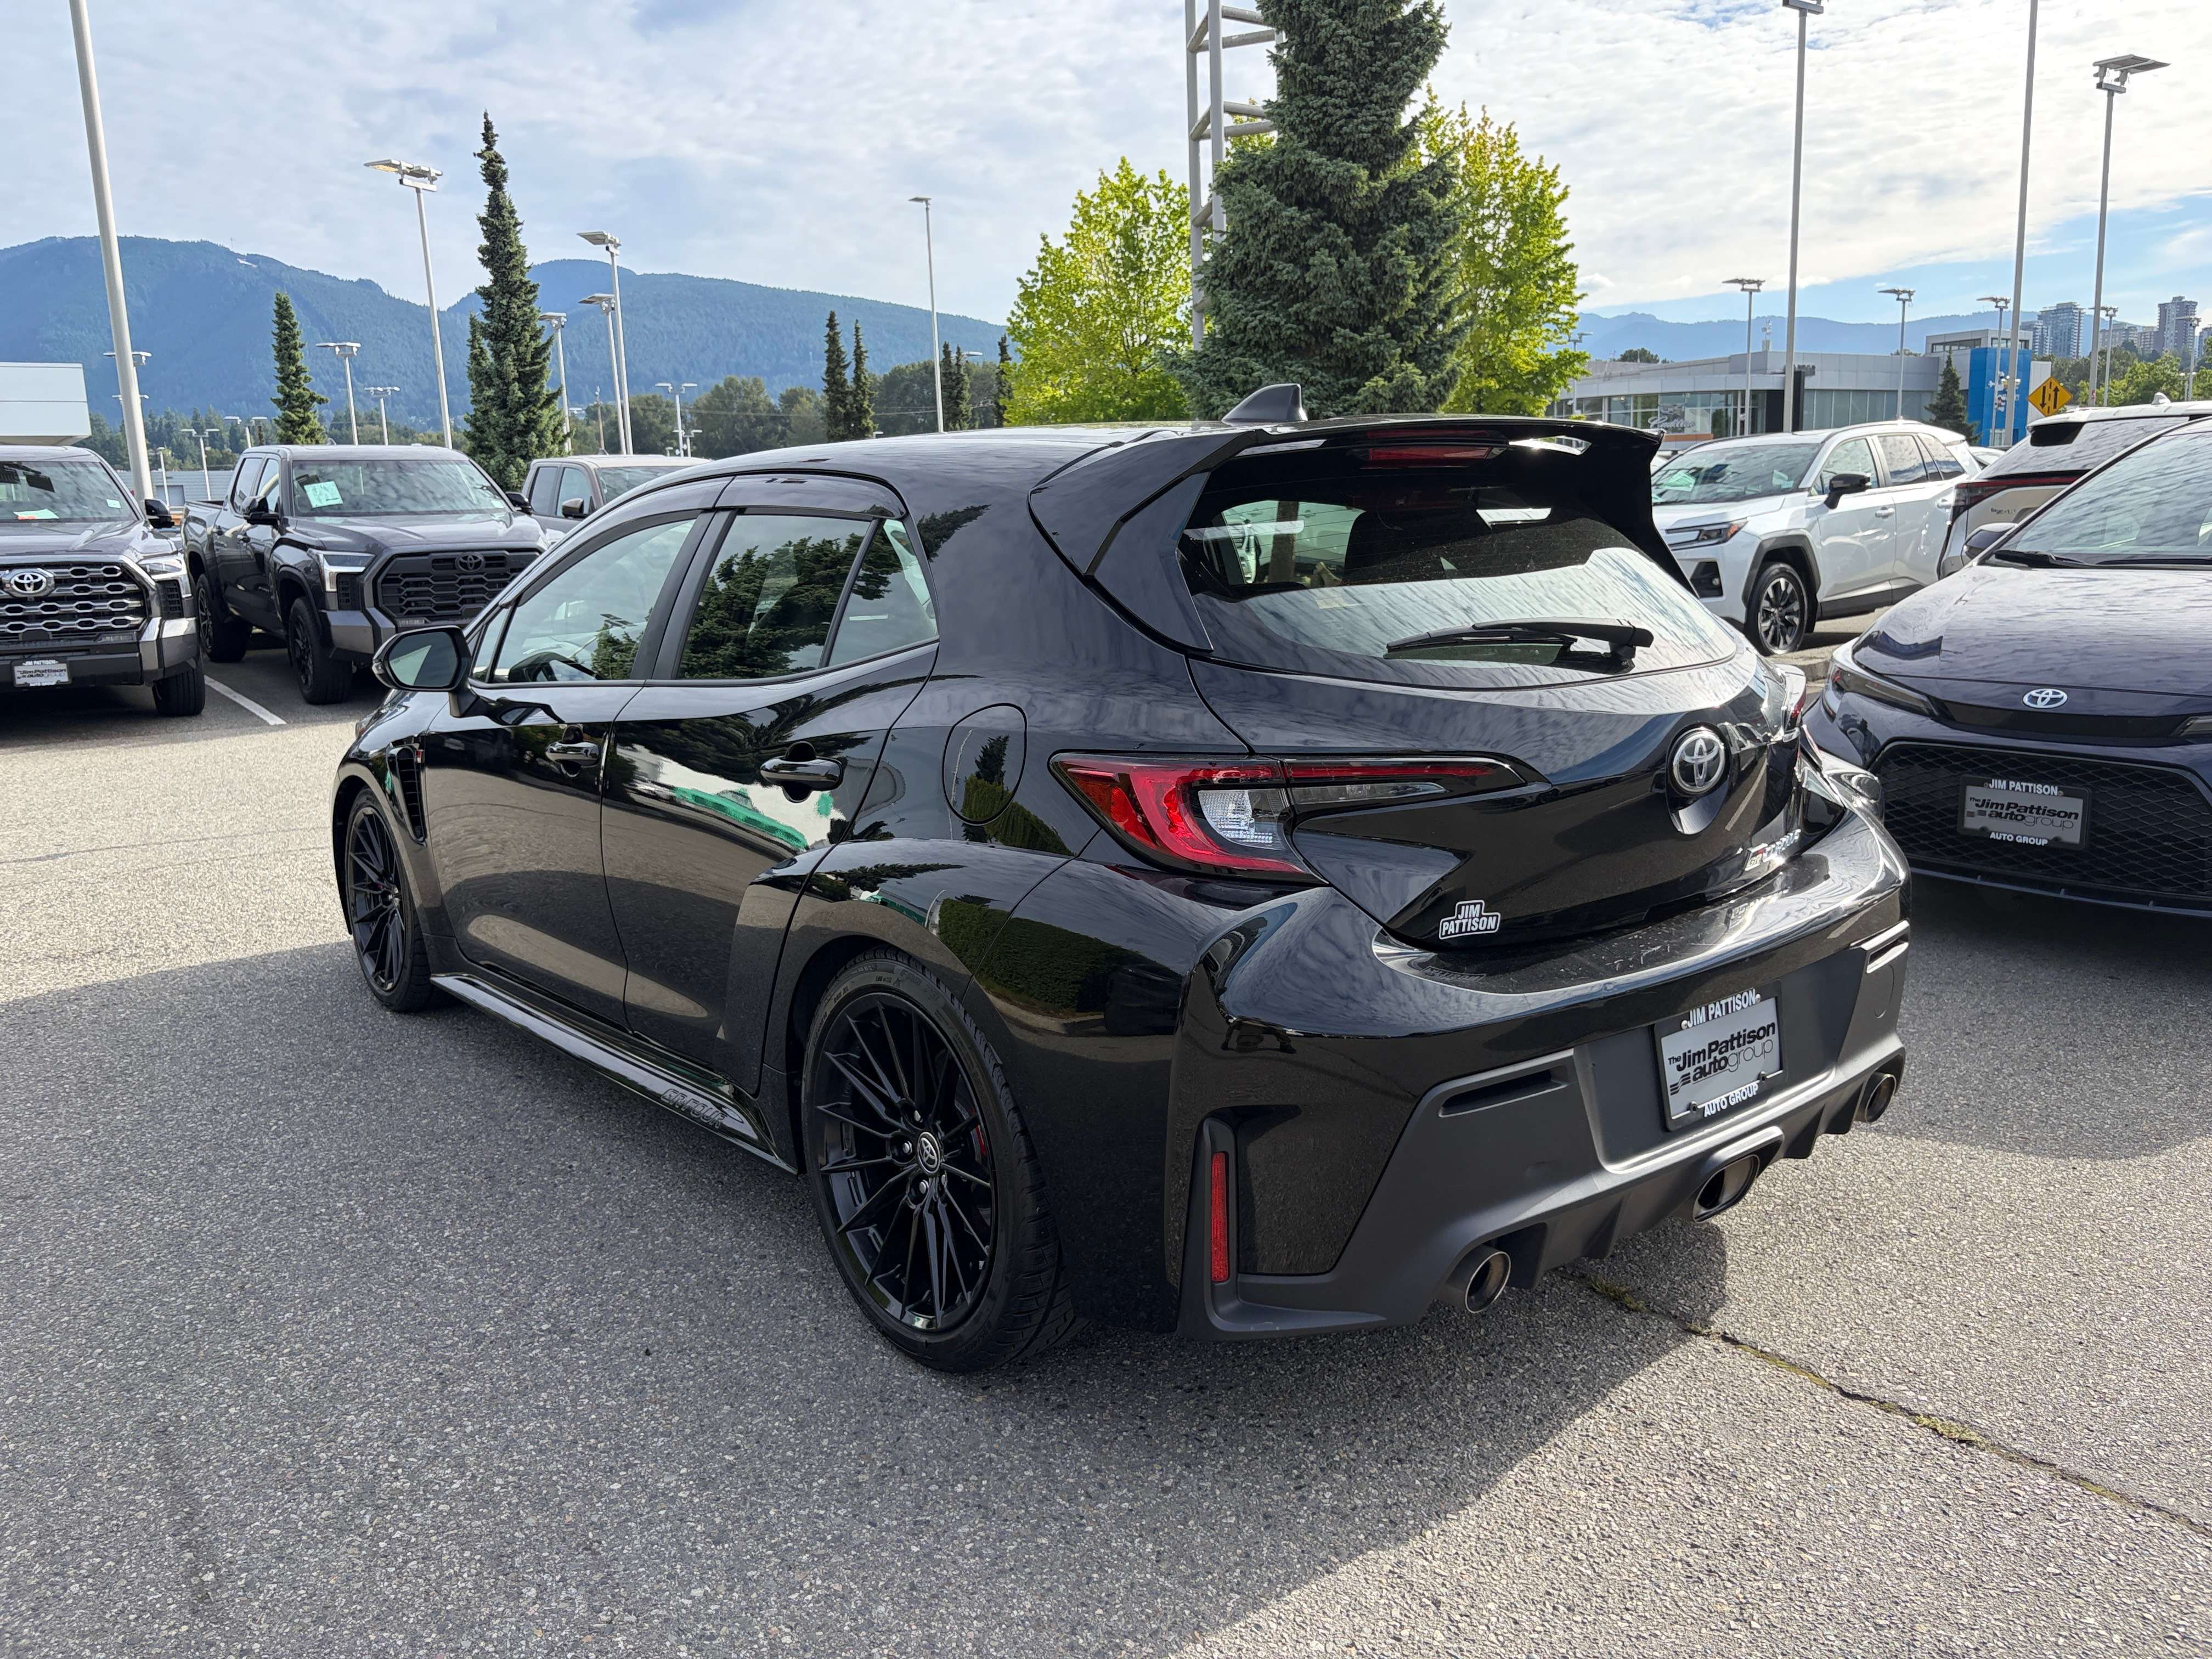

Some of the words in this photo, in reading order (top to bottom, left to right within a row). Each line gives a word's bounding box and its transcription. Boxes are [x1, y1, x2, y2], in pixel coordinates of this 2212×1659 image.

[1989, 779, 2006, 790] JIM
[2009, 781, 2058, 795] PATTISON
[1990, 832, 2014, 842] AUTO
[2016, 836, 2048, 846] GROUP
[1458, 904, 1480, 919] JIM
[1442, 916, 1497, 935] PATTISON
[1688, 1006, 1706, 1028] JIM
[1708, 988, 1756, 1020] PATTISON
[1668, 1054, 1681, 1065] The
[1704, 1097, 1728, 1117] AUTO
[1729, 1082, 1759, 1106] GROUP
